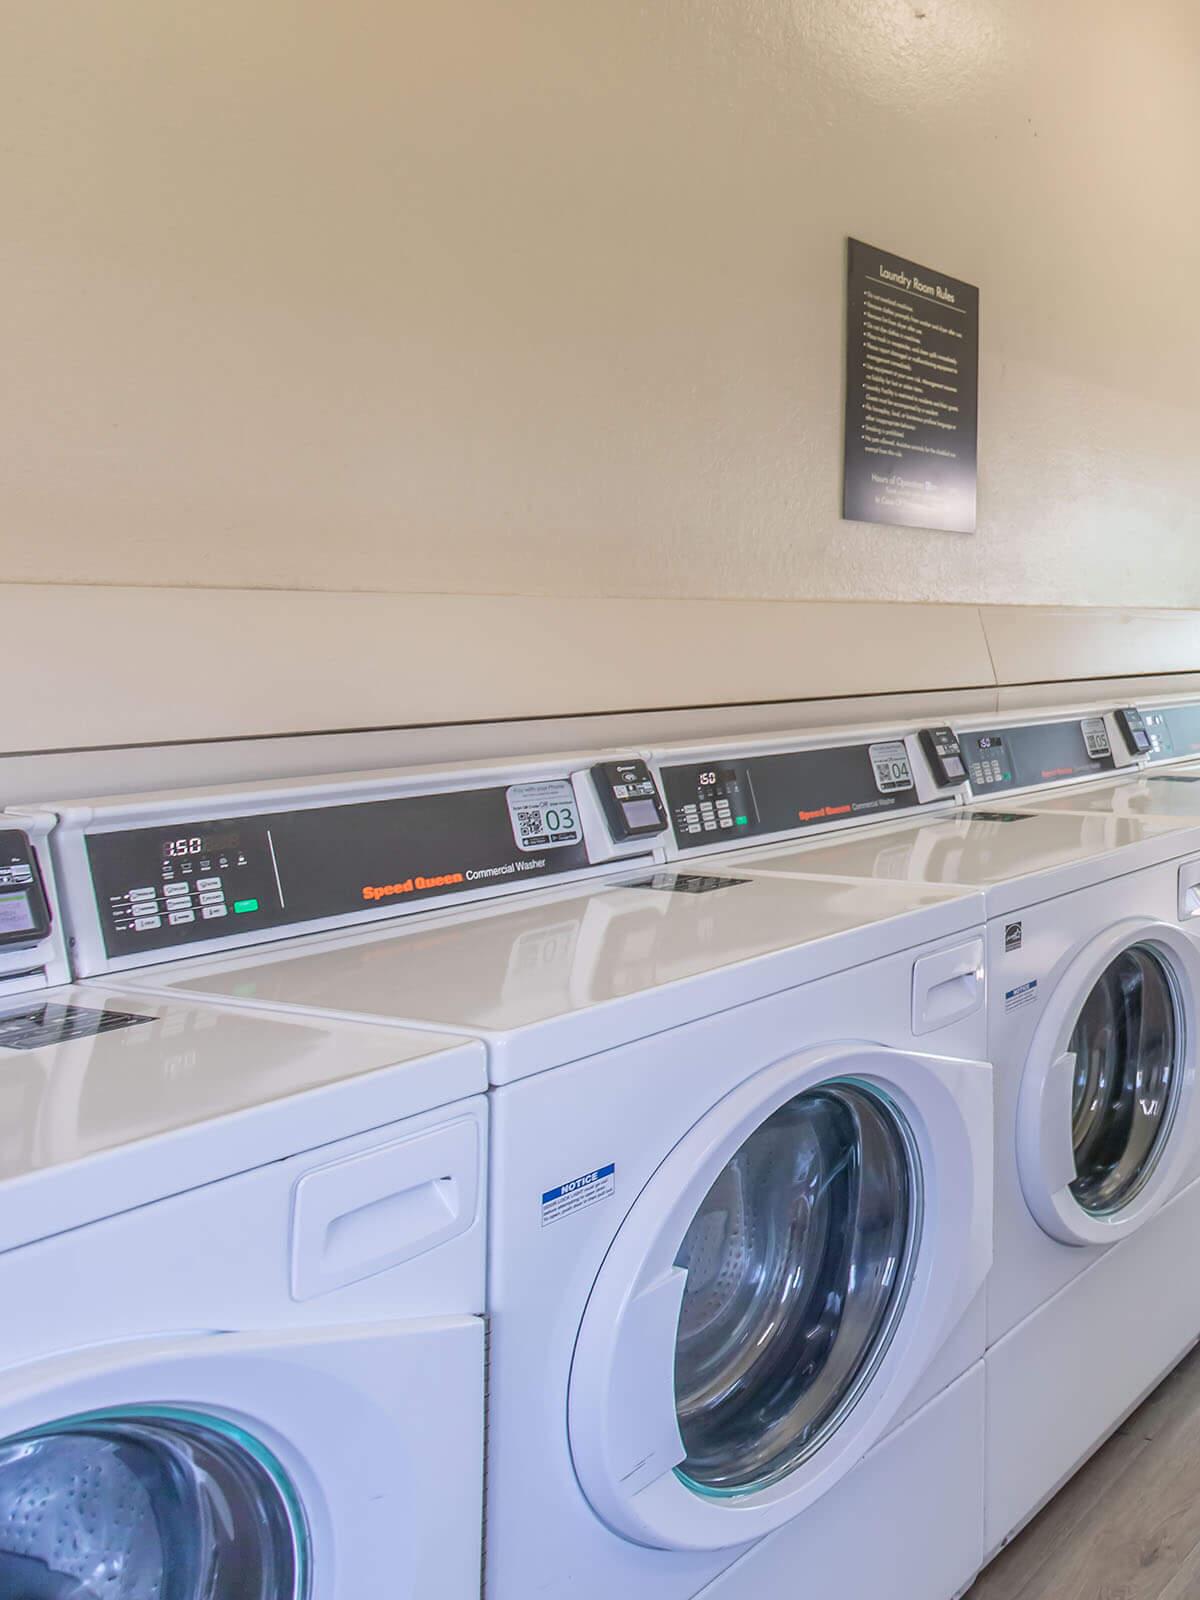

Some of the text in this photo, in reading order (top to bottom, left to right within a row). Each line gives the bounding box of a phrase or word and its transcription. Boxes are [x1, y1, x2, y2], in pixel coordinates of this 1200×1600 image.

[879, 264, 955, 303] Laundry Room Rules
[892, 762, 909, 779] 04
[545, 808, 575, 832] 03
[362, 858, 546, 900] Speed Queen Commercial Washer
[561, 1171, 599, 1195] NOTICE
